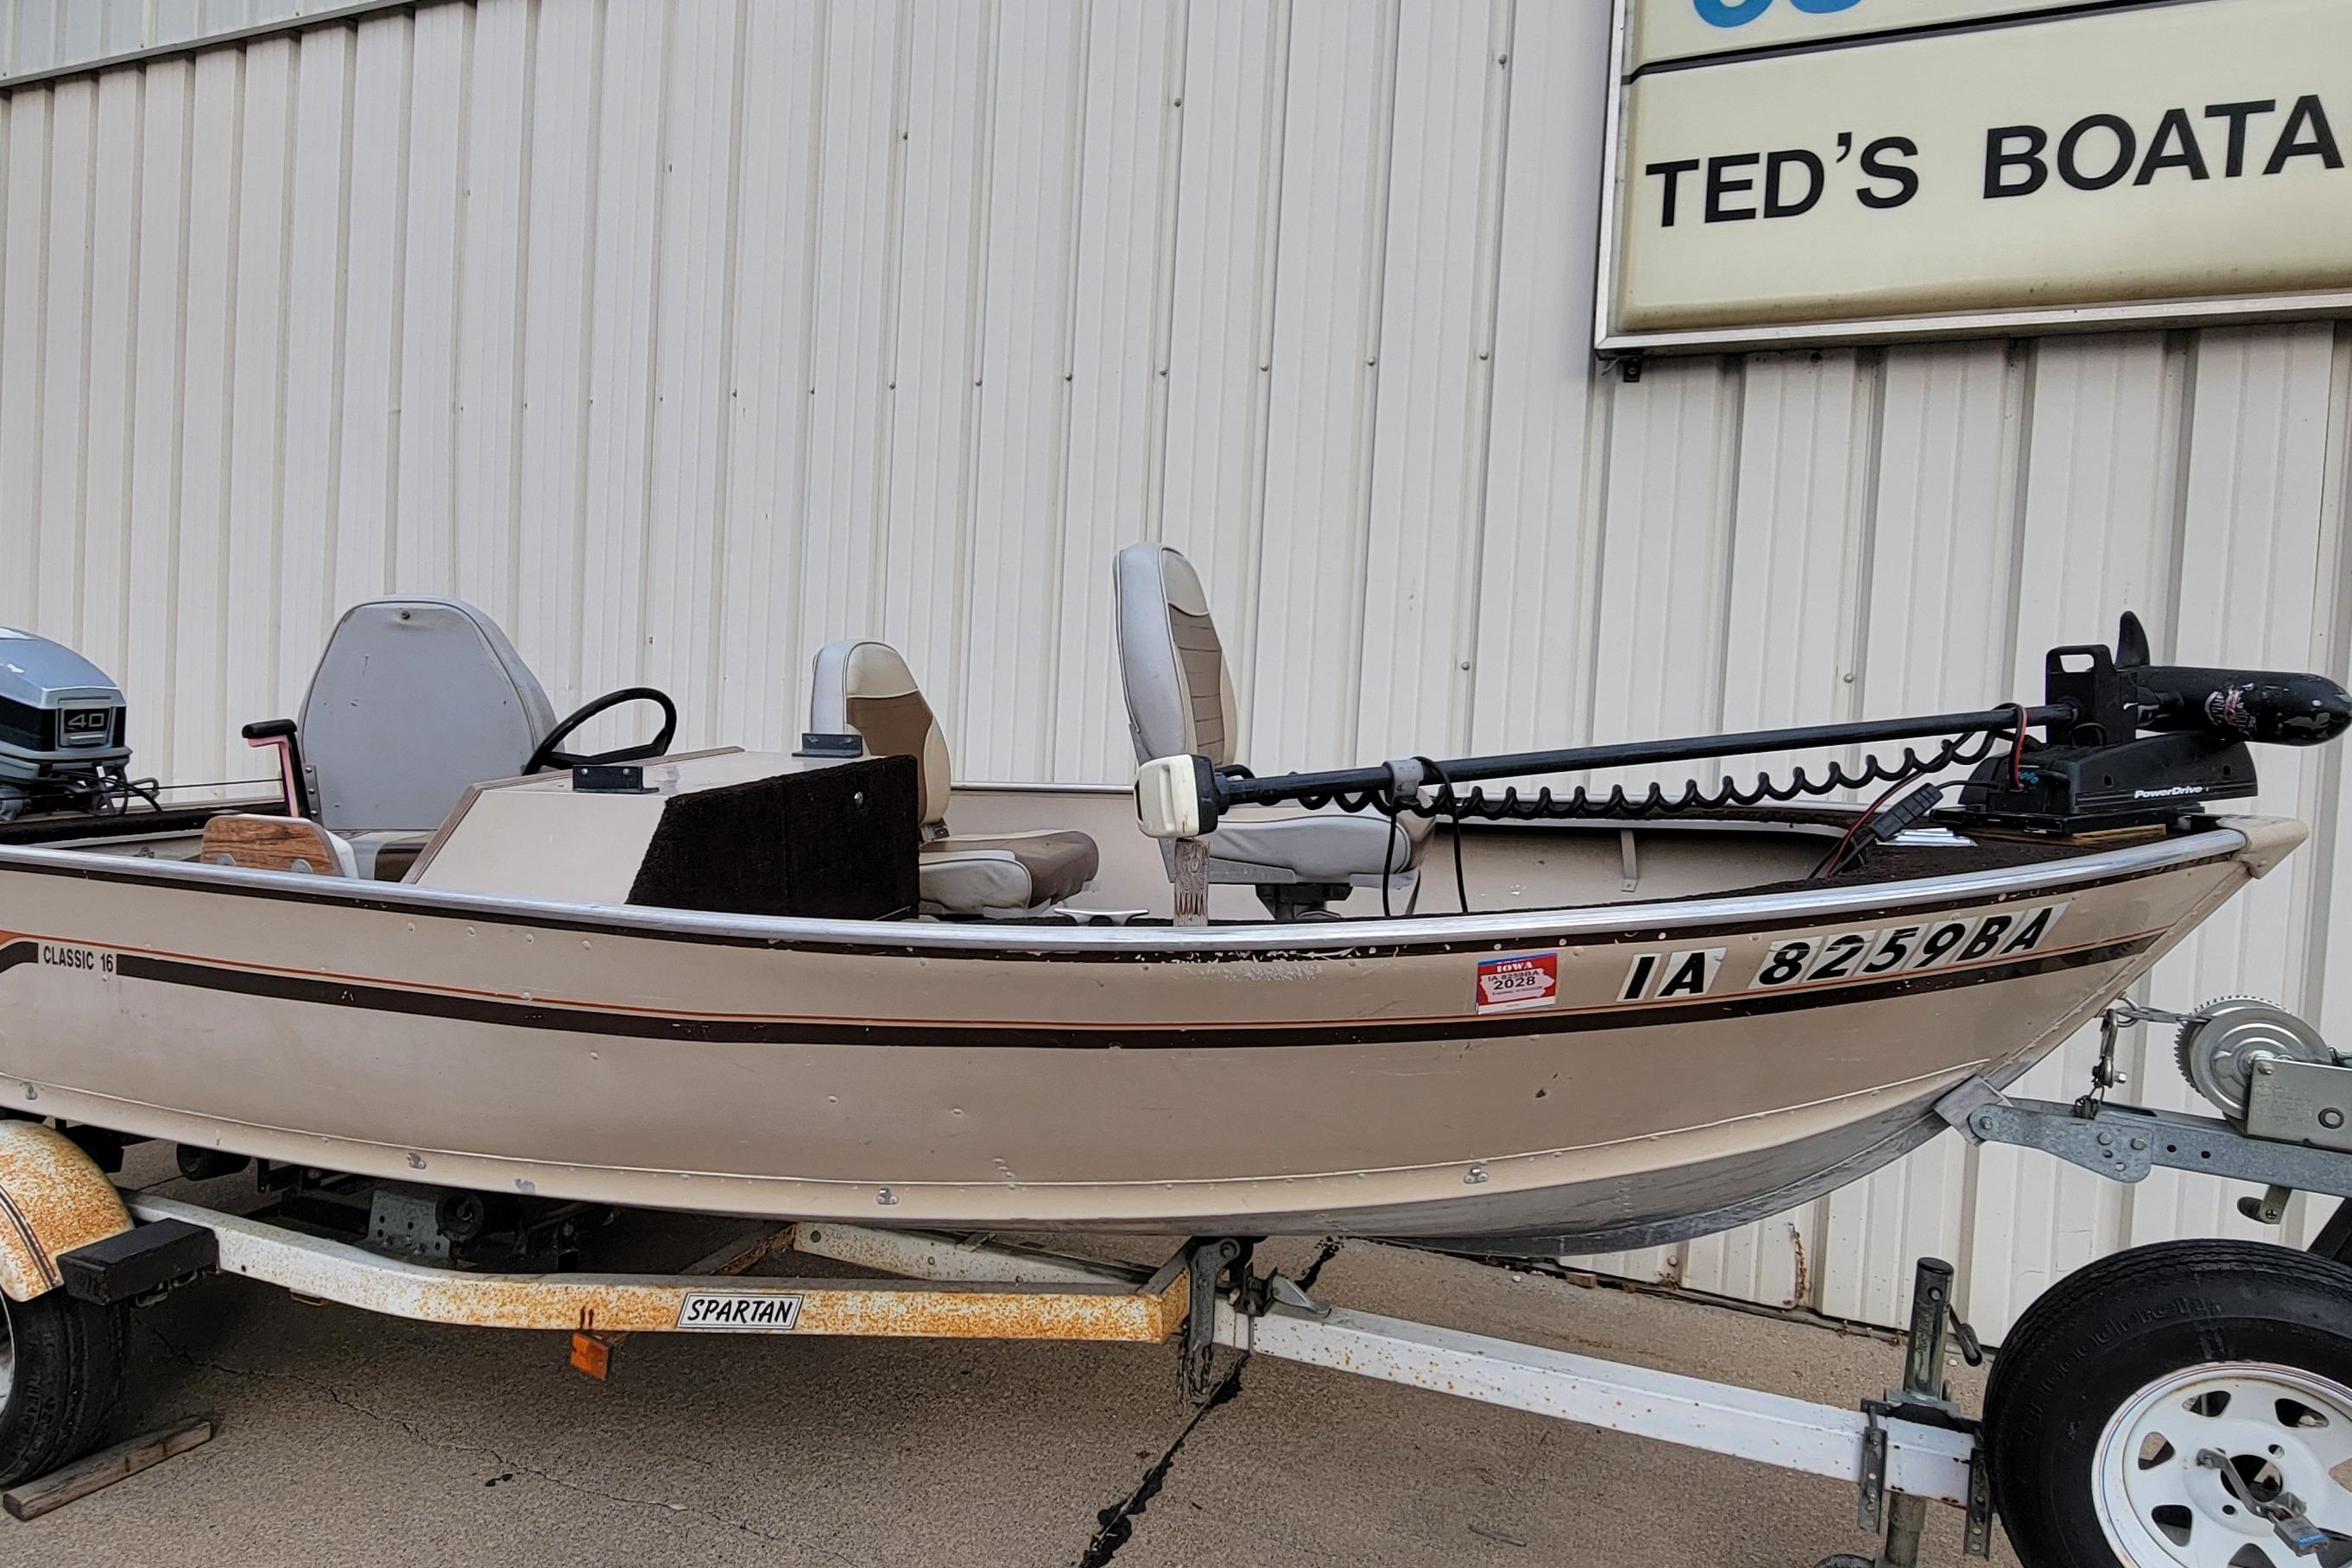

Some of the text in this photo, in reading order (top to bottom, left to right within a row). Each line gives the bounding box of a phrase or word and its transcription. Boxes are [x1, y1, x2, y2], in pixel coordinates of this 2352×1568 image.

[1646, 95, 2345, 227] TED'S BOATA
[67, 713, 104, 728] 40
[2134, 786, 2203, 799] PowerDrive
[43, 945, 114, 972] CLASSIC 16
[1624, 907, 2053, 1000] IA 8259BA
[1496, 961, 1533, 973] IOWA
[1494, 977, 1535, 990] 2028
[687, 1299, 793, 1324] SPARTAN
